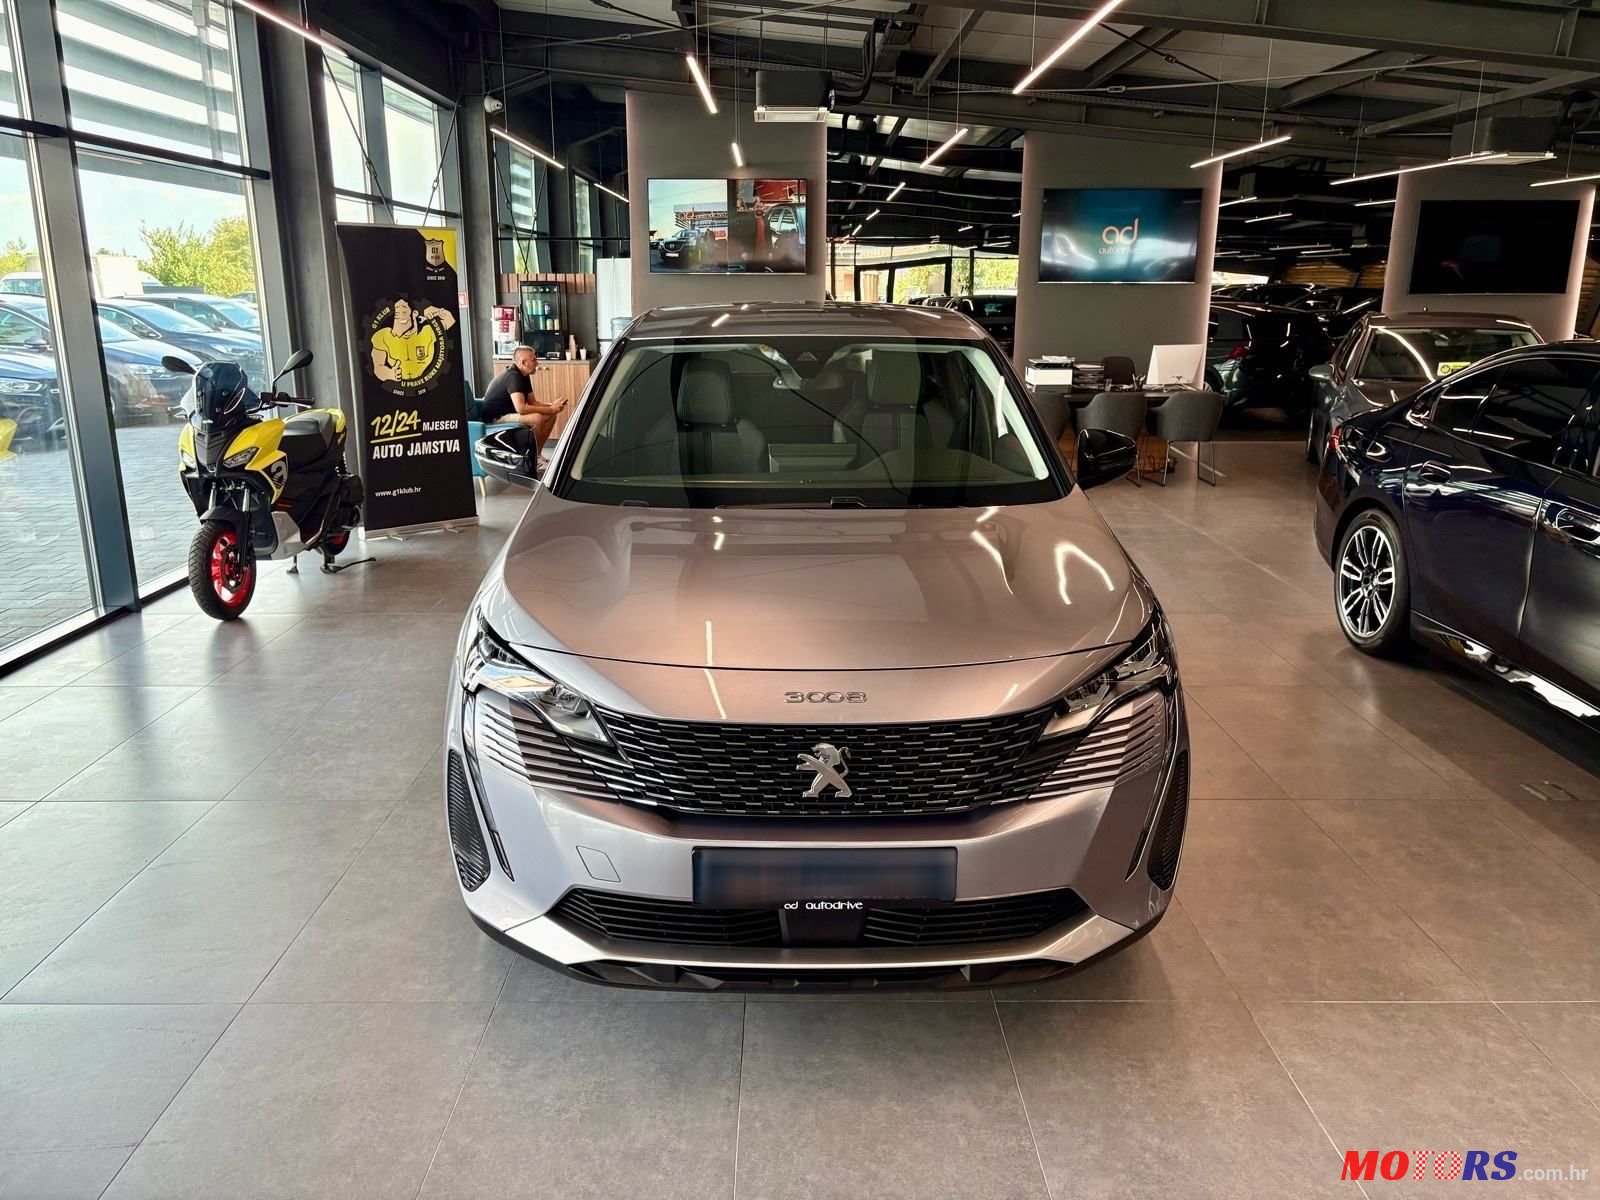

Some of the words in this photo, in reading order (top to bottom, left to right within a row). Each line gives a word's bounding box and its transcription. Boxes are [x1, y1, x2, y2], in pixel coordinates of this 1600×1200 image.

[1102, 217, 1139, 245] ad
[376, 306, 391, 321] KLUB
[407, 379, 425, 388] PRAVE
[371, 410, 421, 437] 12/24
[422, 420, 459, 432] MJESECI
[372, 444, 404, 460] AUTO
[406, 439, 461, 457] JAMSTVA
[374, 486, 422, 497] www.g1klub.hr
[783, 691, 868, 704] 3008
[783, 901, 799, 910] ad
[805, 900, 864, 910] autodrive
